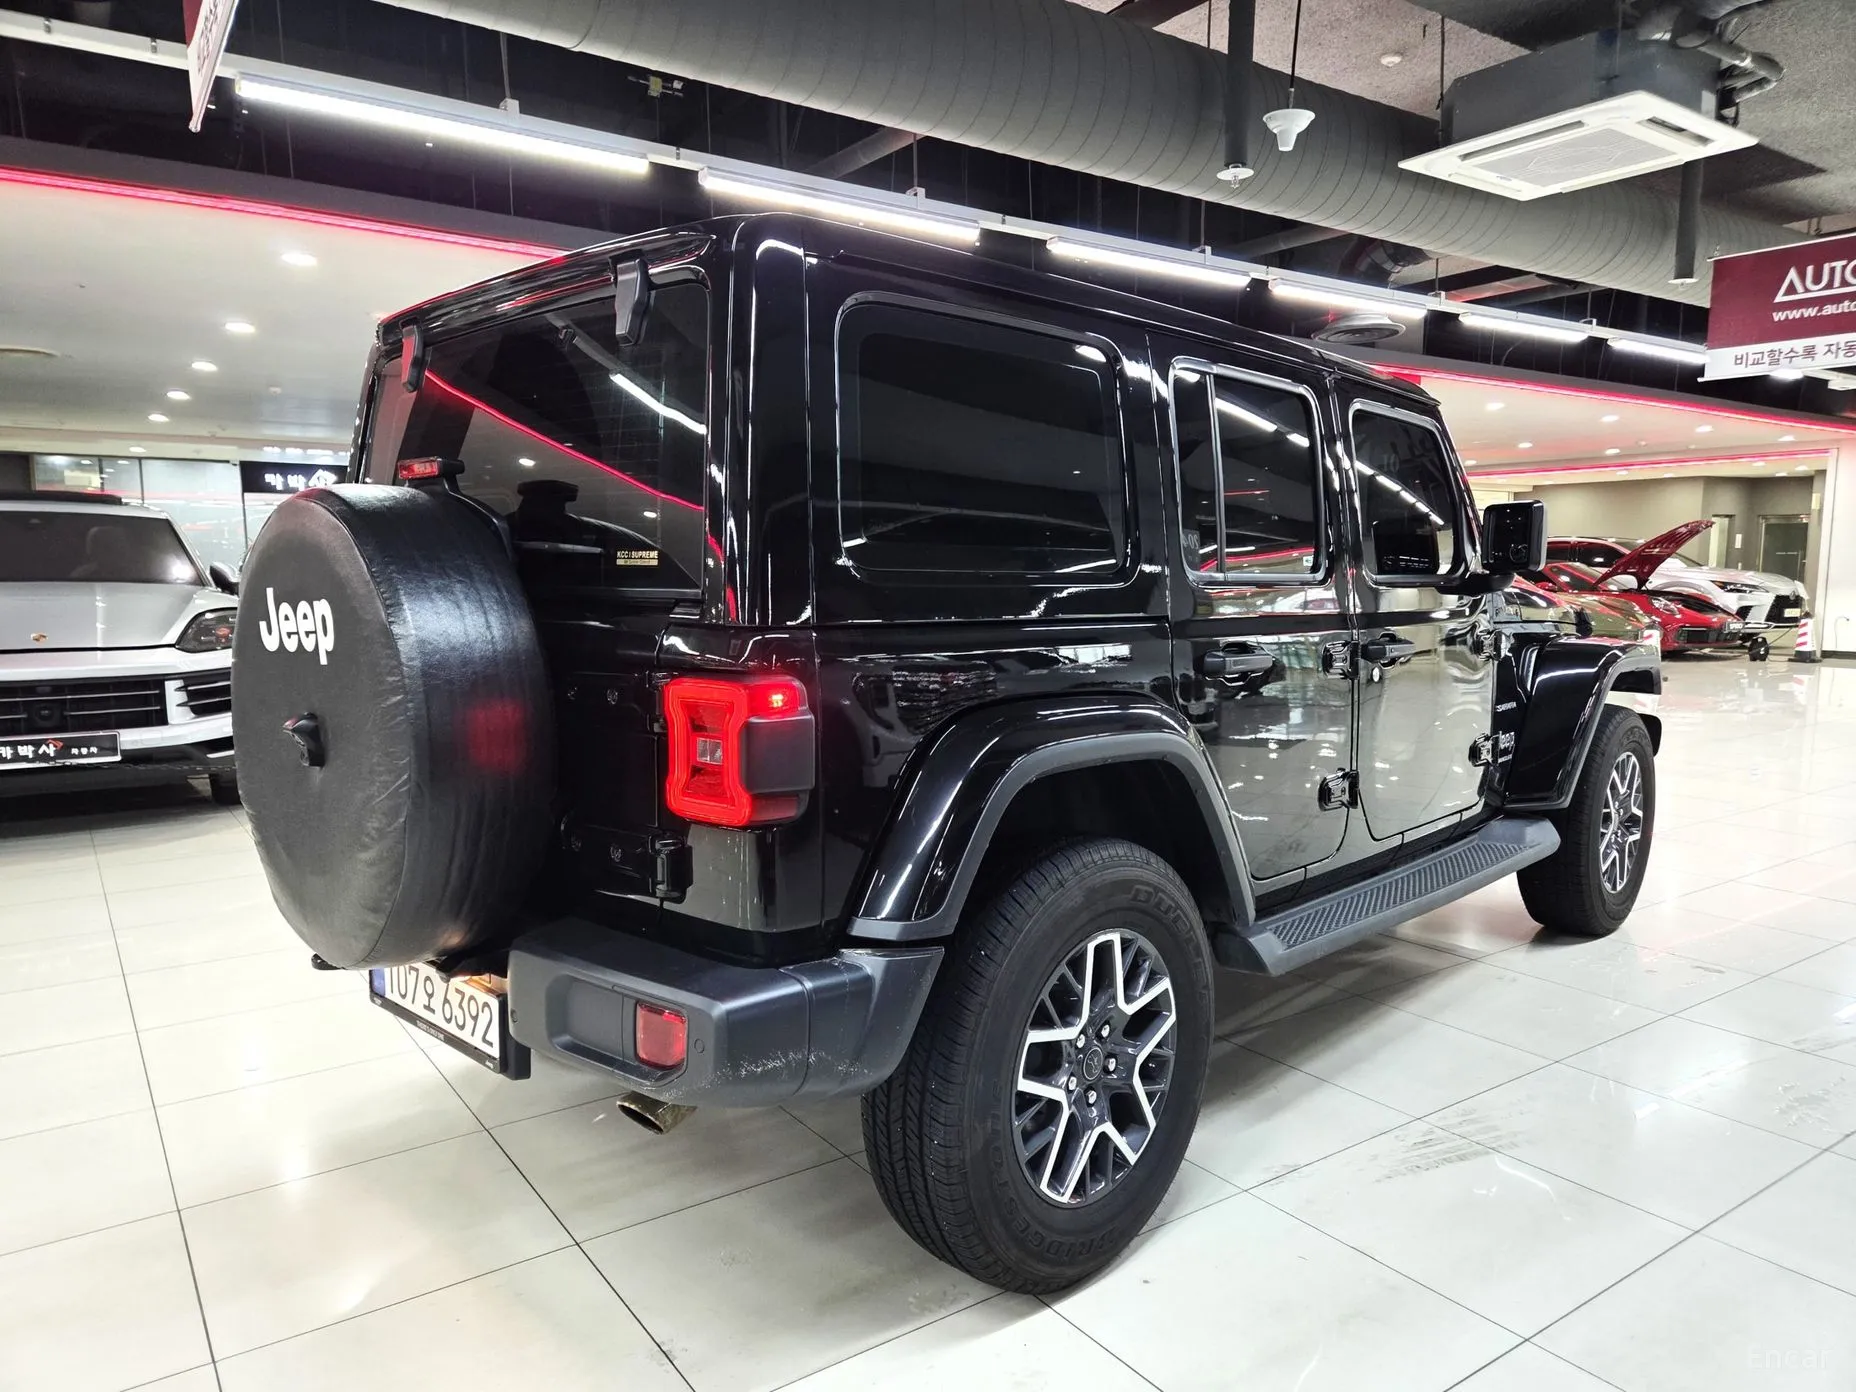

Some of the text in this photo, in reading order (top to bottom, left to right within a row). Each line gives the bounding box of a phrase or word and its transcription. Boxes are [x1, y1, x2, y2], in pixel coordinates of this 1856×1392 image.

[1734, 344, 1818, 368] 비교할수록
[259, 587, 335, 666] Jeep
[441, 983, 495, 1049] 6392
